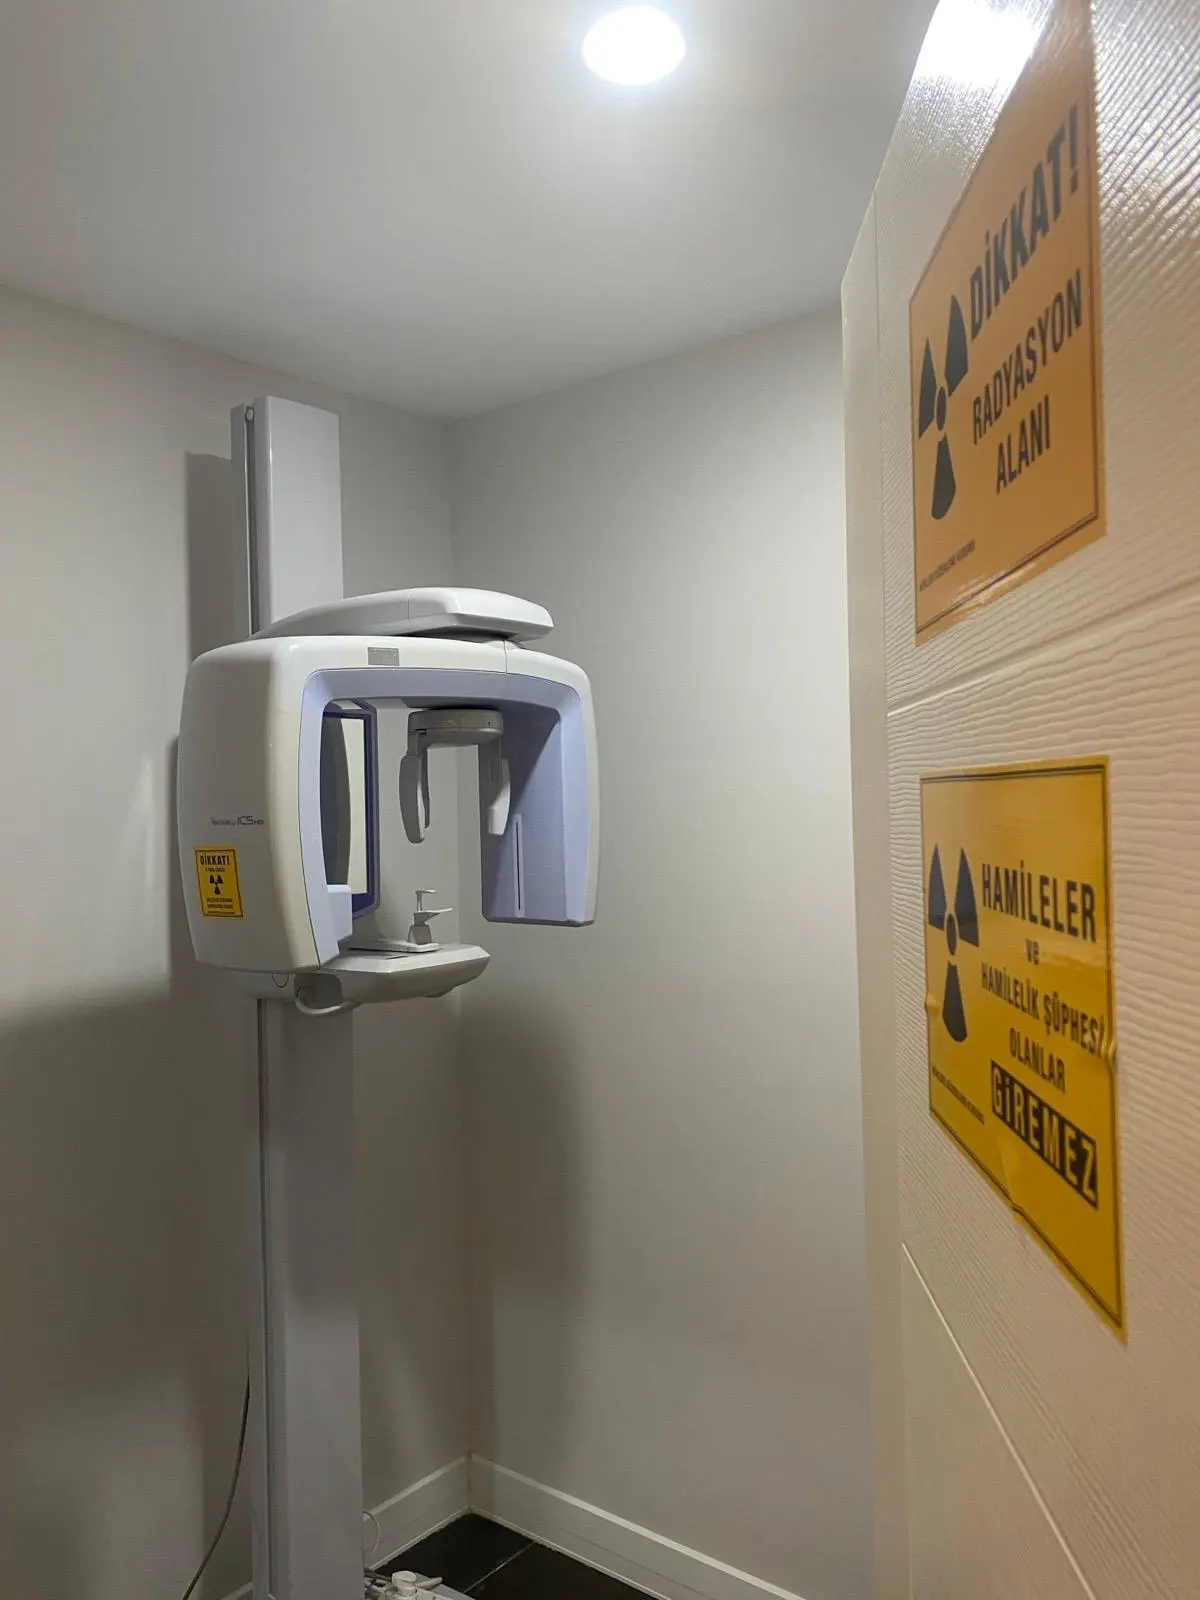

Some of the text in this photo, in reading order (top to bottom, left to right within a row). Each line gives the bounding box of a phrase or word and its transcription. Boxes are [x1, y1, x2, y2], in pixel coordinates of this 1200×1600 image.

[969, 102, 1079, 343] DİKKAT!
[972, 267, 1082, 446] RADYASYON
[995, 394, 1051, 496] ALANI
[981, 859, 1097, 944] HAMİLELER
[981, 960, 1040, 1021] HAMİLELİK
[1025, 938, 1040, 966] ve
[1009, 1026, 1066, 1095] OLANLAR
[991, 1064, 1097, 1203] GİREMEZ
